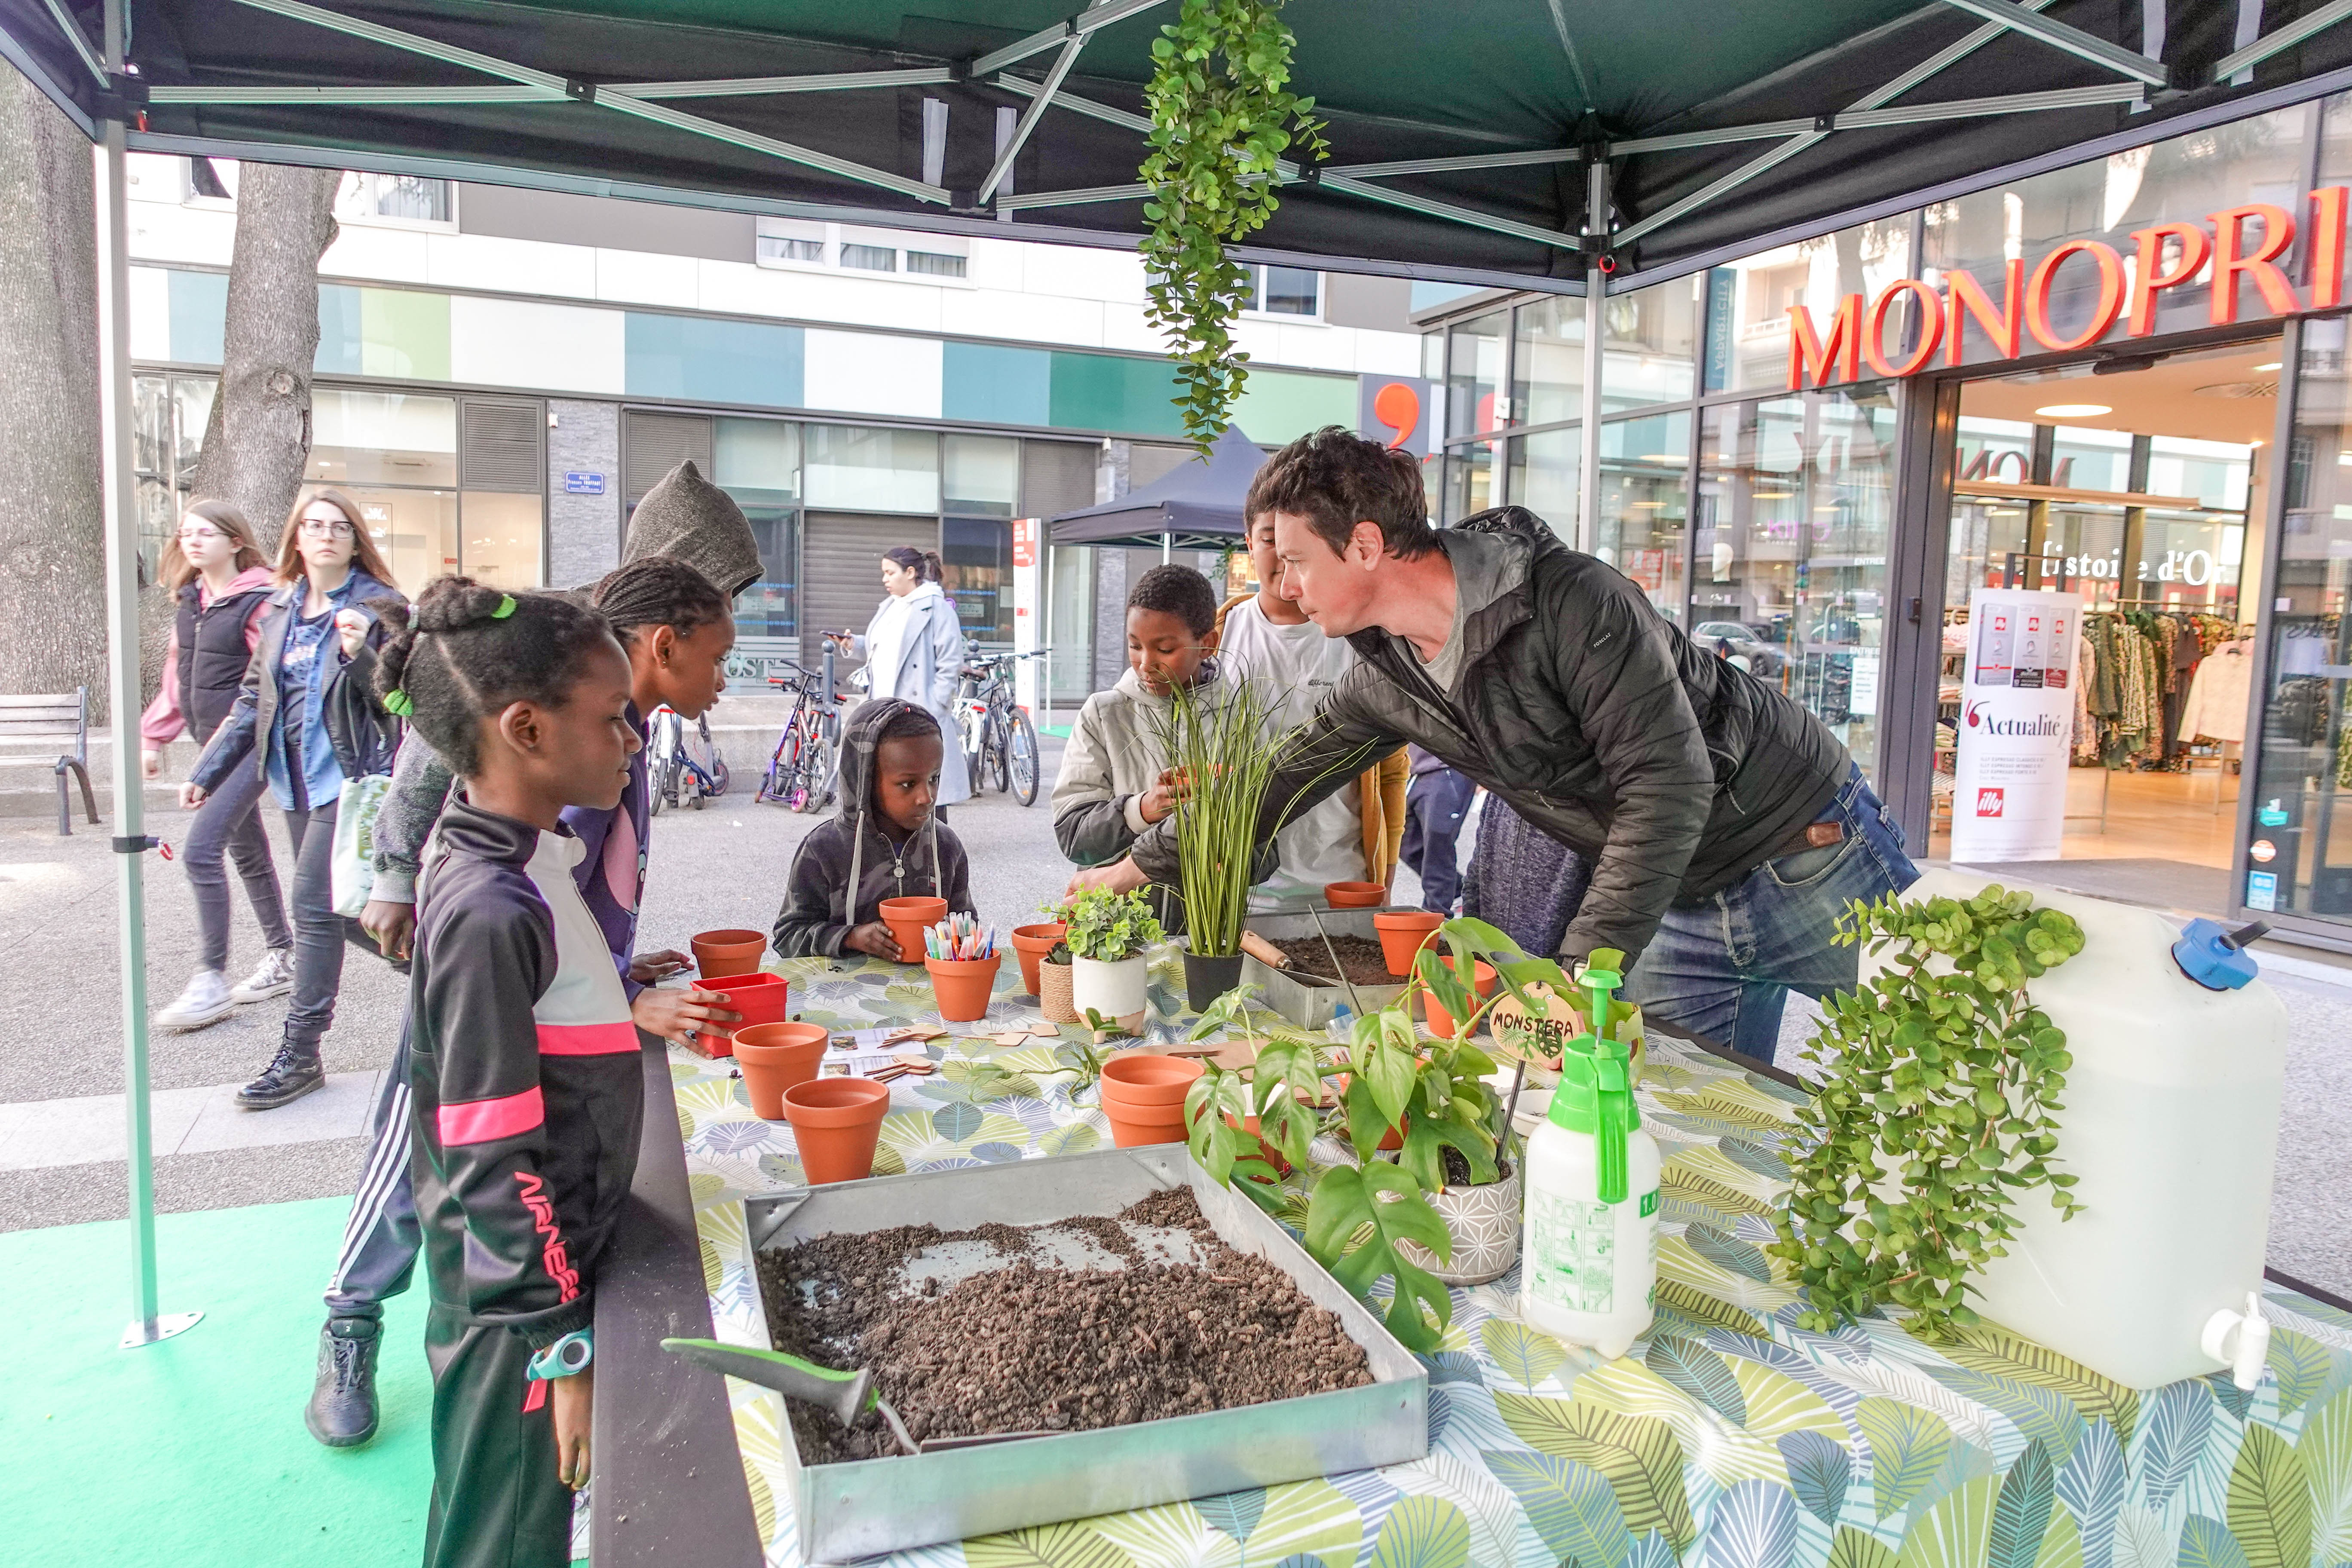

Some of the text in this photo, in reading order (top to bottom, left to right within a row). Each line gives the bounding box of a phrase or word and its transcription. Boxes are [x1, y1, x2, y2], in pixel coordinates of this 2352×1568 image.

[1785, 186, 2350, 390] MONOPRI
[1978, 791, 2003, 816] illy
[1493, 1011, 1573, 1039] MONSTERA
